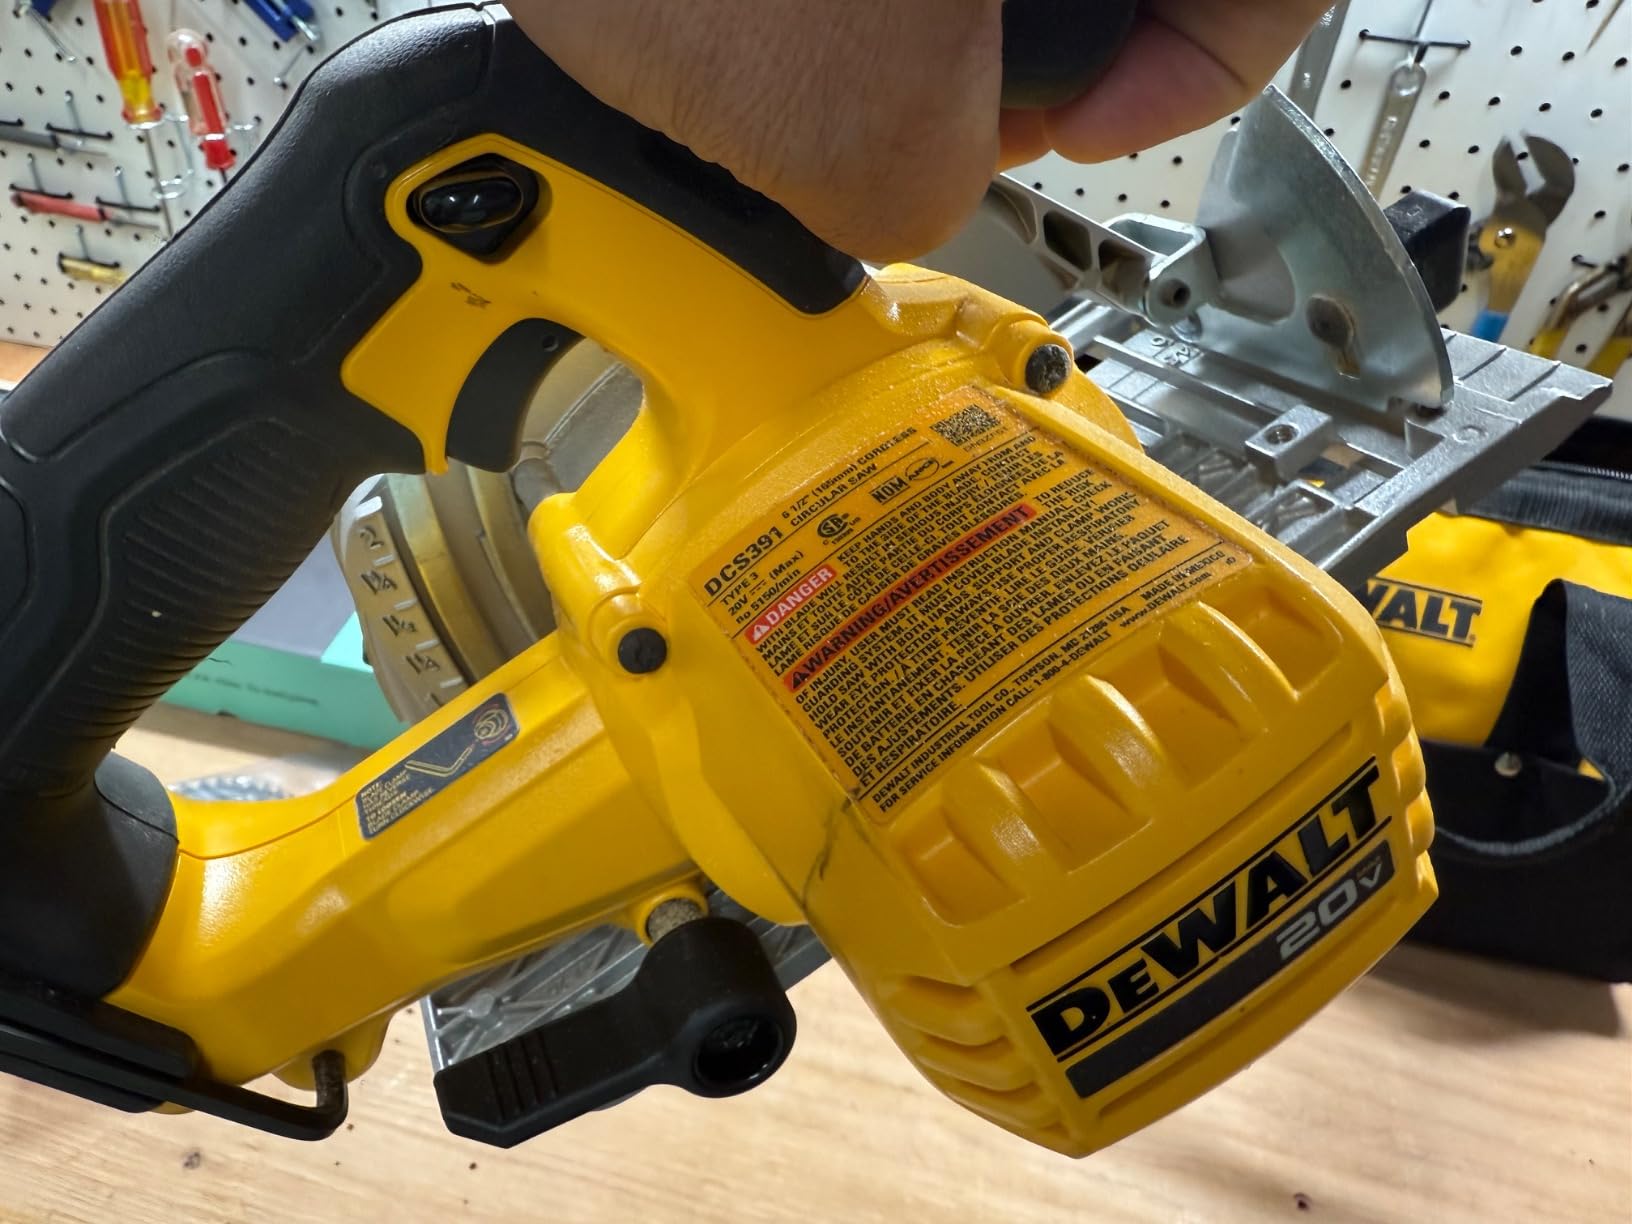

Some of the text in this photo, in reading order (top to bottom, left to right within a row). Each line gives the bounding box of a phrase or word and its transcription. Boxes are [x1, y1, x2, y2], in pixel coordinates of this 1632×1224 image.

[359, 525, 384, 550] 2
[705, 527, 782, 595] DCS391
[756, 628, 783, 652] WITH
[783, 599, 816, 628] BLADE
[816, 580, 842, 600] WILL
[843, 550, 880, 580] RESULT
[881, 539, 895, 551] IN
[895, 510, 941, 541] SERIOUS
[989, 462, 1022, 481] TENIR
[1021, 451, 1042, 463] LES
[762, 628, 796, 660] MAINS
[796, 616, 809, 630] ET
[811, 589, 844, 616] TOUTE
[845, 563, 879, 591] AUTRE
[879, 536, 917, 564] PARTIE
[917, 524, 934, 537] DU
[935, 501, 971, 525] CORPS
[1030, 459, 1047, 468] DE
[1046, 451, 1063, 460] LA
[768, 641, 796, 668] LAME
[796, 628, 809, 642] ET
[811, 611, 833, 630] SUR
[832, 599, 846, 612] LE
[874, 567, 889, 579] DE
[938, 514, 967, 533] TOUT
[969, 483, 1019, 514] CONTACT
[1021, 466, 1050, 484] AVEC
[1049, 459, 1064, 468] LA
[790, 463, 876, 526] CIRCULAR SAW
[837, 541, 860, 561] KEEP
[863, 516, 898, 542] HANDS
[900, 501, 921, 517] AND
[922, 482, 949, 502] BODY
[952, 464, 981, 484] AWAY
[981, 448, 1012, 466] FROM
[1013, 436, 1035, 450] AND
[843, 555, 858, 566] TO
[858, 540, 880, 555] THE
[880, 522, 905, 541] SIDE
[906, 511, 919, 523] OF
[920, 498, 942, 512] THE
[981, 448, 1029, 476] CONTACT
[872, 477, 907, 502] NOM
[1033, 469, 1092, 502] TO REDUCE
[1042, 479, 1092, 508] THE RISK
[720, 579, 750, 605] TYPE
[728, 550, 803, 615] 20V (Max)
[750, 569, 800, 610] 5150/min
[766, 569, 831, 624] DANGER
[774, 492, 1026, 676] LAME RISQUE DE CAUSER DE GRAVES BLESSURES.
[795, 688, 808, 703] OF
[850, 631, 879, 655] USER
[879, 605, 910, 632] MUST
[911, 583, 941, 607] READ
[943, 534, 1018, 584] INSTRUCTION
[1072, 481, 1111, 503] CHECK
[802, 500, 1096, 711] GUARDING SYSTEM. MUST COVER BLADE INSTANTLY!
[803, 508, 1031, 672] WARNING/AVERTISSEMENT
[808, 512, 1093, 721] HOLD SAW WITH BOTH SUPPORT AND CLAMP
[815, 499, 1140, 728] WEAR EYE PROTECTION. ALWAYS USE PROPER RESPIRATORY
[823, 566, 1046, 738] PROTECTION. TITRE LIRE LE
[829, 533, 1127, 748] LE TENIR LA SCIE DES DEUX MAINS.
[838, 708, 891, 756] SOUTENIR
[890, 694, 905, 709] ET
[906, 669, 940, 696] FIXER
[939, 656, 957, 671] LA
[1002, 589, 1054, 623] OUVRER.
[1053, 555, 1106, 589] ENLEVEZ
[1105, 545, 1123, 557] LE
[1121, 520, 1169, 548] PAQUET
[844, 534, 1166, 767] DE BATTERIE EN CHANGEANT DES LAMES OU EN FAISANT
[852, 537, 1188, 776] DES AJUSTEMENTS. UTILISER DES PROTECTIONS OCULAIRE
[1119, 572, 1210, 627] www.DEWALT.com
[1141, 579, 1173, 600] MADE
[1185, 551, 1224, 574] MEXICO
[859, 700, 961, 786] ET RESPIRATOIRE.
[872, 606, 1130, 802] DEWALT INDUSTRIAL TOOL 21286 USA
[879, 793, 899, 811] FOR
[899, 758, 937, 794] SERVICE
[938, 705, 1005, 760] INFORMATION
[1033, 630, 1110, 685] 1-800-4-DEWALT
[1031, 765, 1379, 1056] DEWALT
